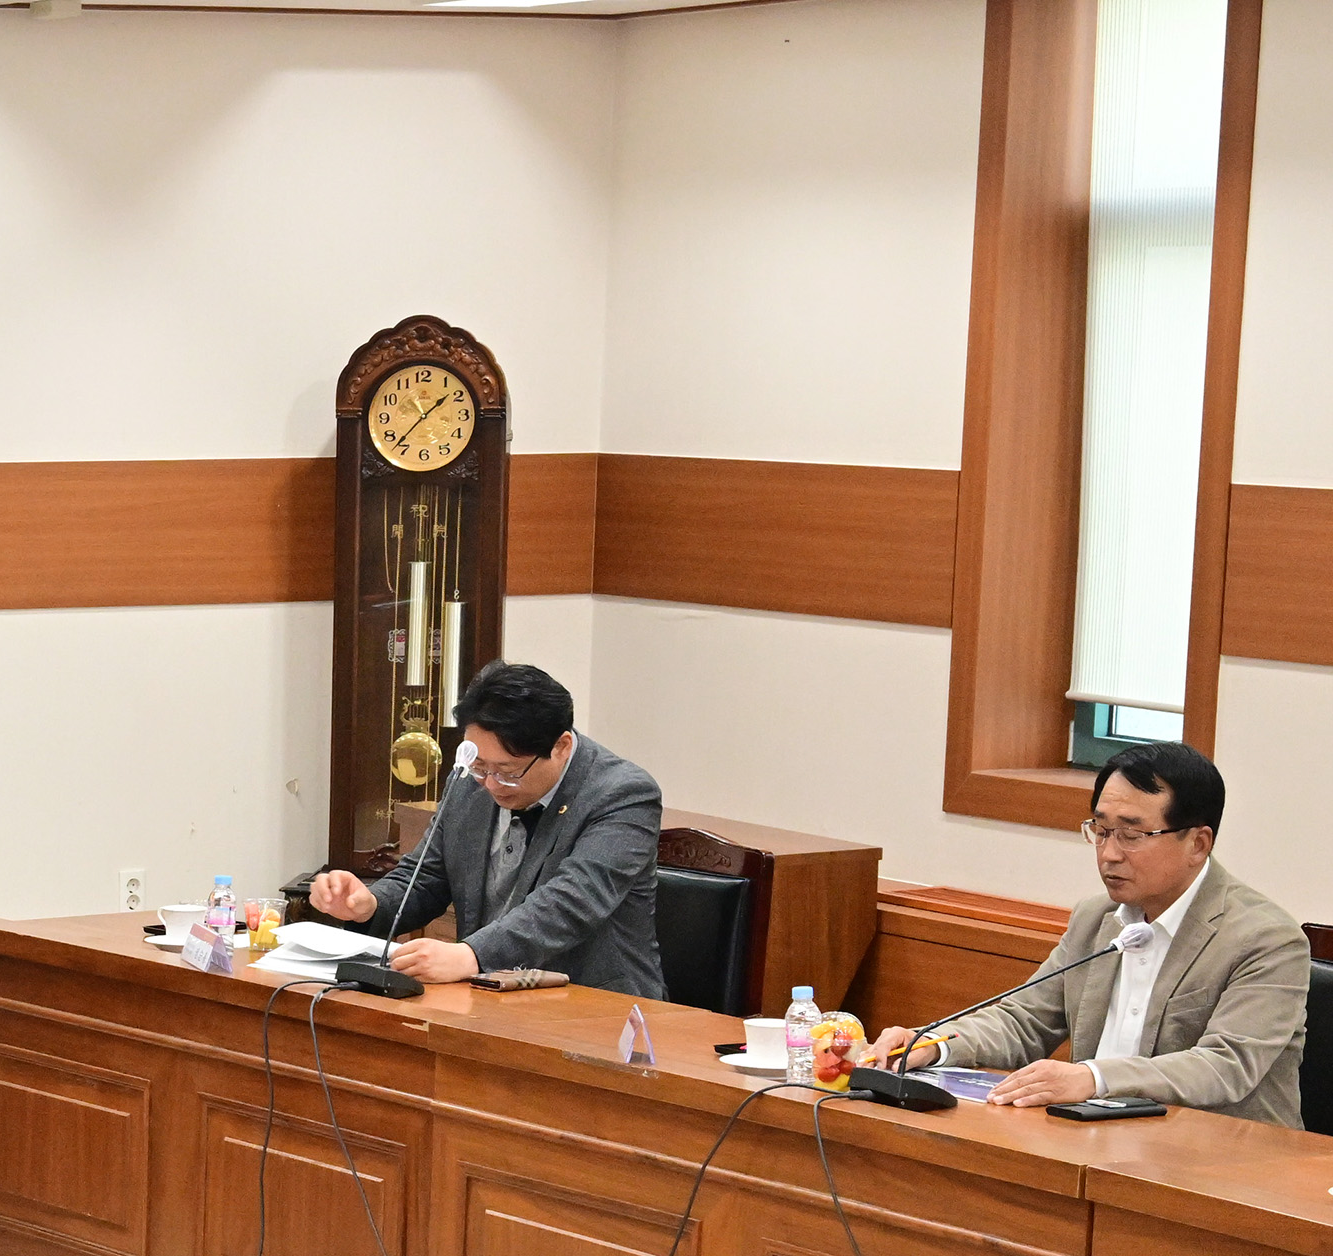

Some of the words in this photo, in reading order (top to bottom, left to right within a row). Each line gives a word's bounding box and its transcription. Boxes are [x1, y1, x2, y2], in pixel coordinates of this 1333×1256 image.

[415, 369, 432, 383] 12
[443, 376, 448, 388] 1
[397, 377, 410, 390] 11
[383, 393, 398, 406] 10
[453, 390, 464, 402] 2
[379, 412, 390, 424] 9
[458, 409, 470, 421] 3
[384, 429, 396, 442] 8
[451, 427, 463, 439] 4
[398, 444, 410, 455] 7
[419, 448, 430, 461] 6
[439, 442, 451, 455] 5
